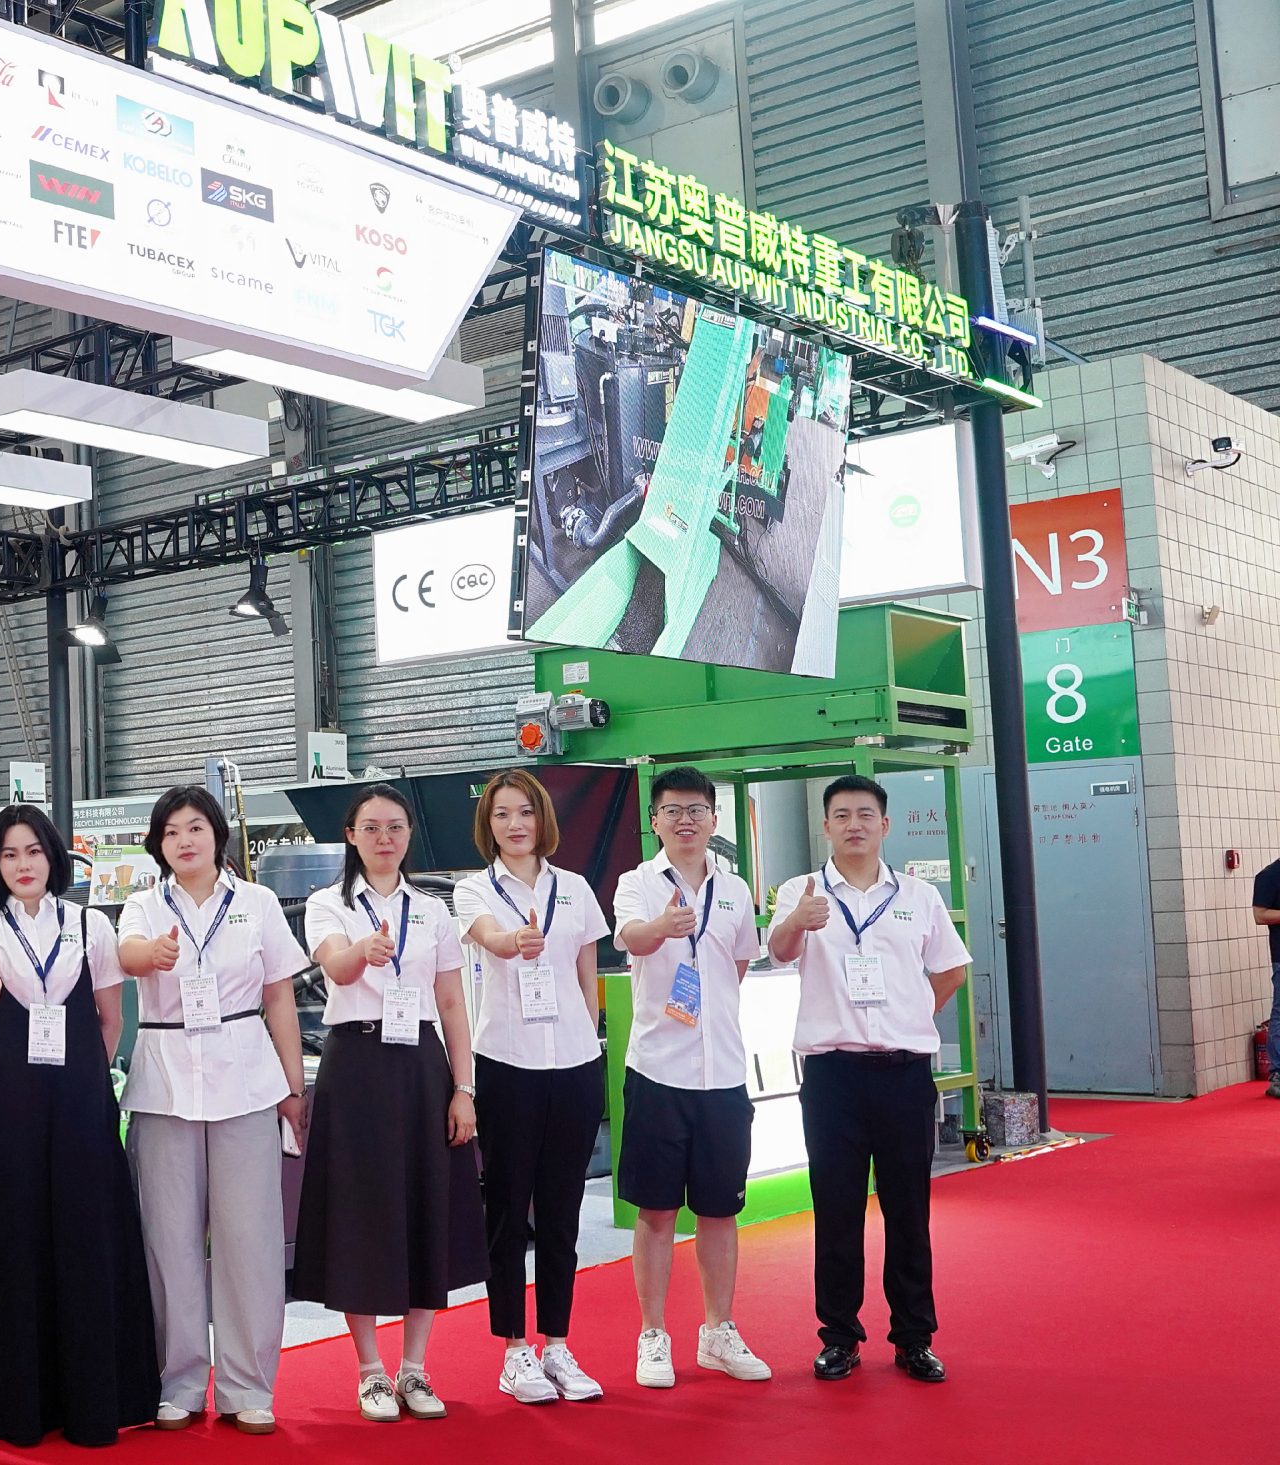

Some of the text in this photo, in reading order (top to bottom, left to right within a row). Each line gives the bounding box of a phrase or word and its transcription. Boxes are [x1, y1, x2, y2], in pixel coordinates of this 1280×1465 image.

[52, 133, 109, 162] CEMEX
[123, 152, 193, 188] KOBELCO
[229, 186, 267, 210] SKG
[53, 219, 88, 250] FTE
[355, 224, 408, 255] KOSO
[604, 138, 972, 348] 江苏奥普威特重工有限公司
[127, 242, 195, 270] TUBACEX
[210, 265, 275, 294] sicame
[609, 213, 707, 278] JIANGSU
[712, 253, 789, 318] AUPWIT
[793, 286, 896, 352] INDUSTRIAL
[367, 308, 406, 343] TGK
[1011, 528, 1109, 600] N3
[392, 570, 435, 612] CE
[456, 573, 489, 590] CQC
[1055, 637, 1070, 654] 门
[1046, 663, 1087, 725] 8
[1046, 735, 1094, 755] Gate
